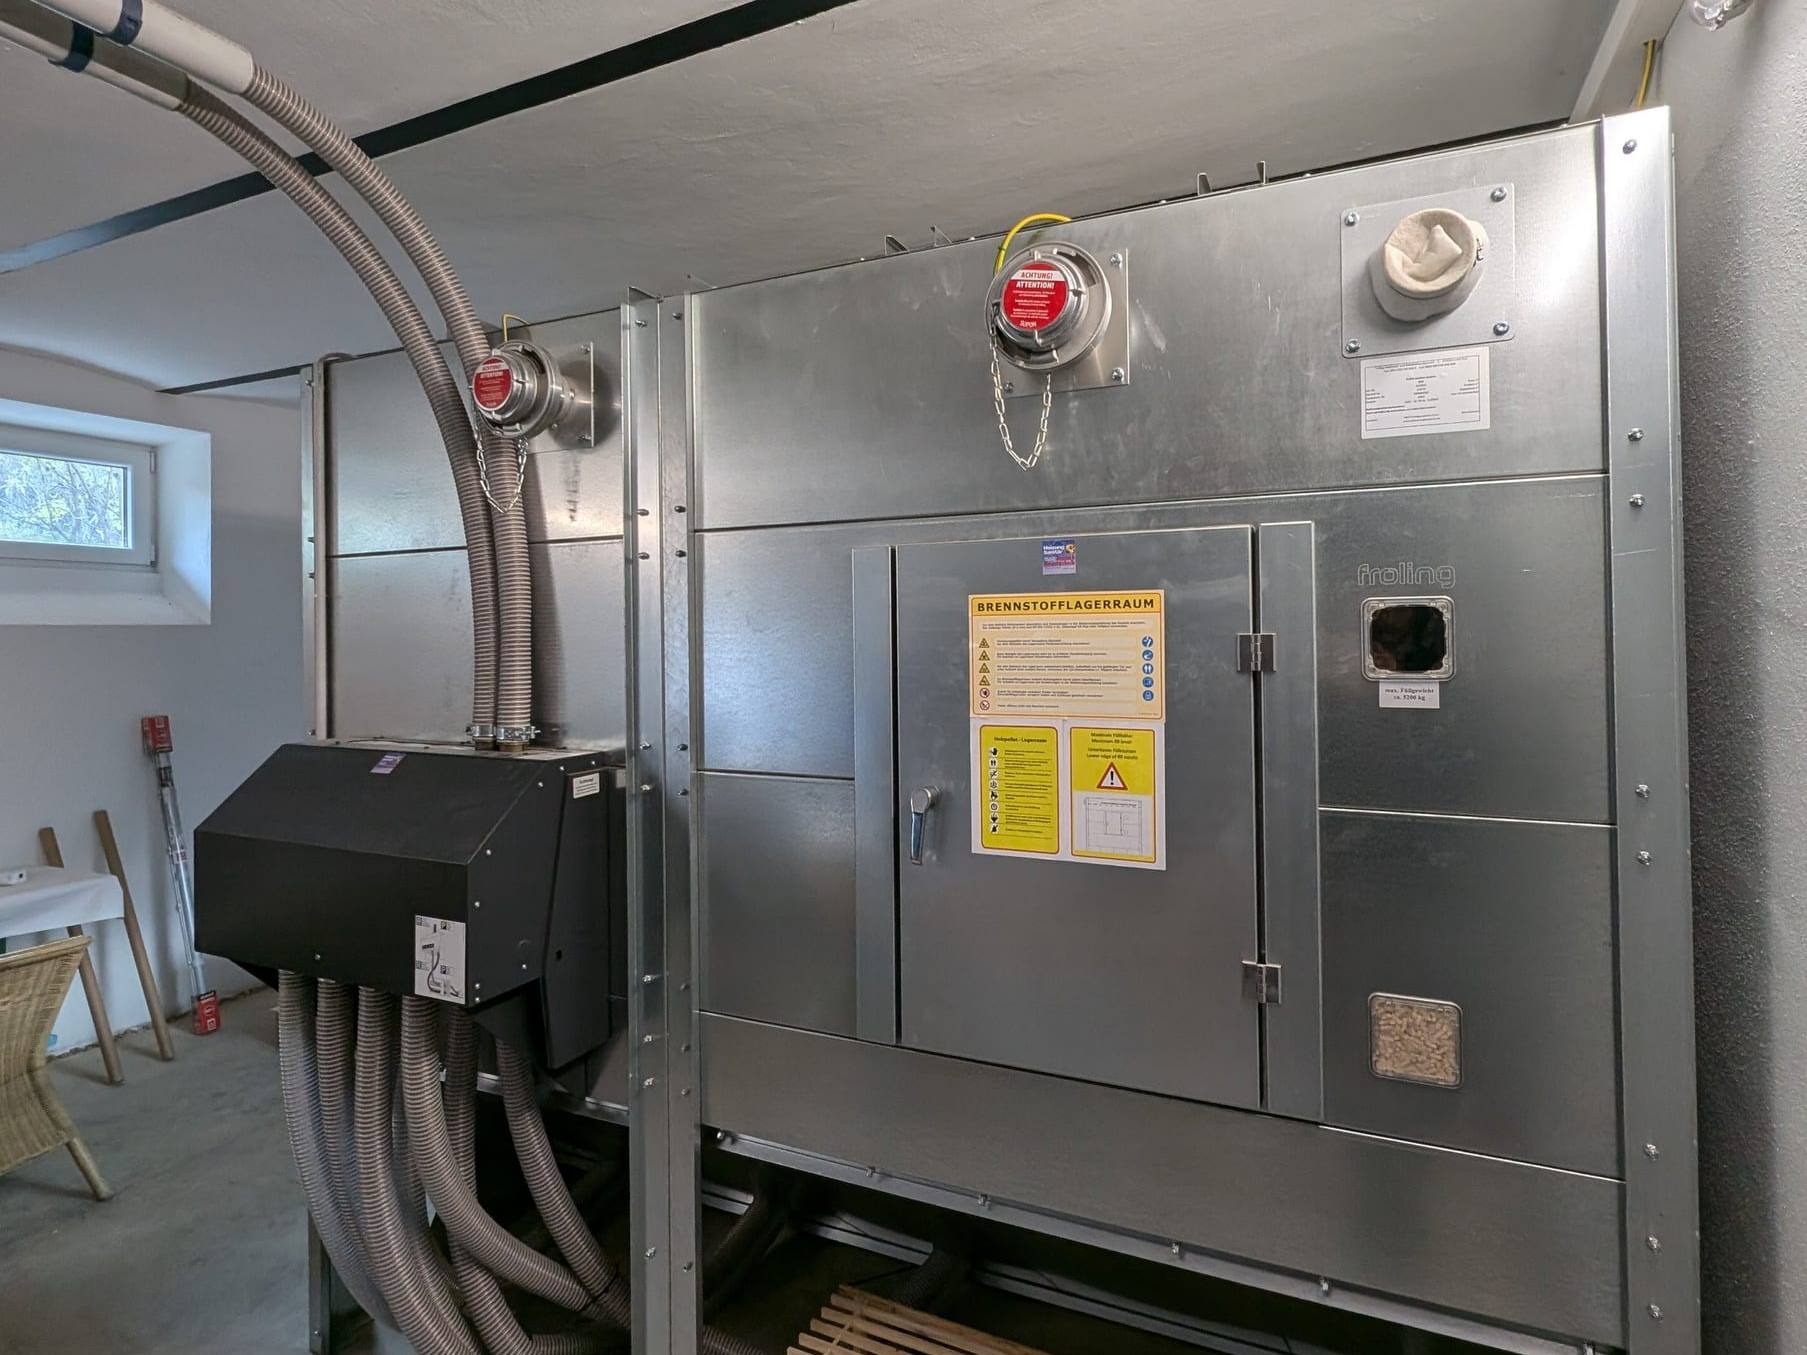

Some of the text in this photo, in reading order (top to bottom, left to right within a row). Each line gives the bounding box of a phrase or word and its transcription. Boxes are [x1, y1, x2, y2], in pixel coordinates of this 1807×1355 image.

[1021, 271, 1054, 279] ACHTUNG!
[1016, 281, 1055, 289] ATTENTION!
[977, 598, 1154, 612] BRENNSTOFFLAGERRAUM
